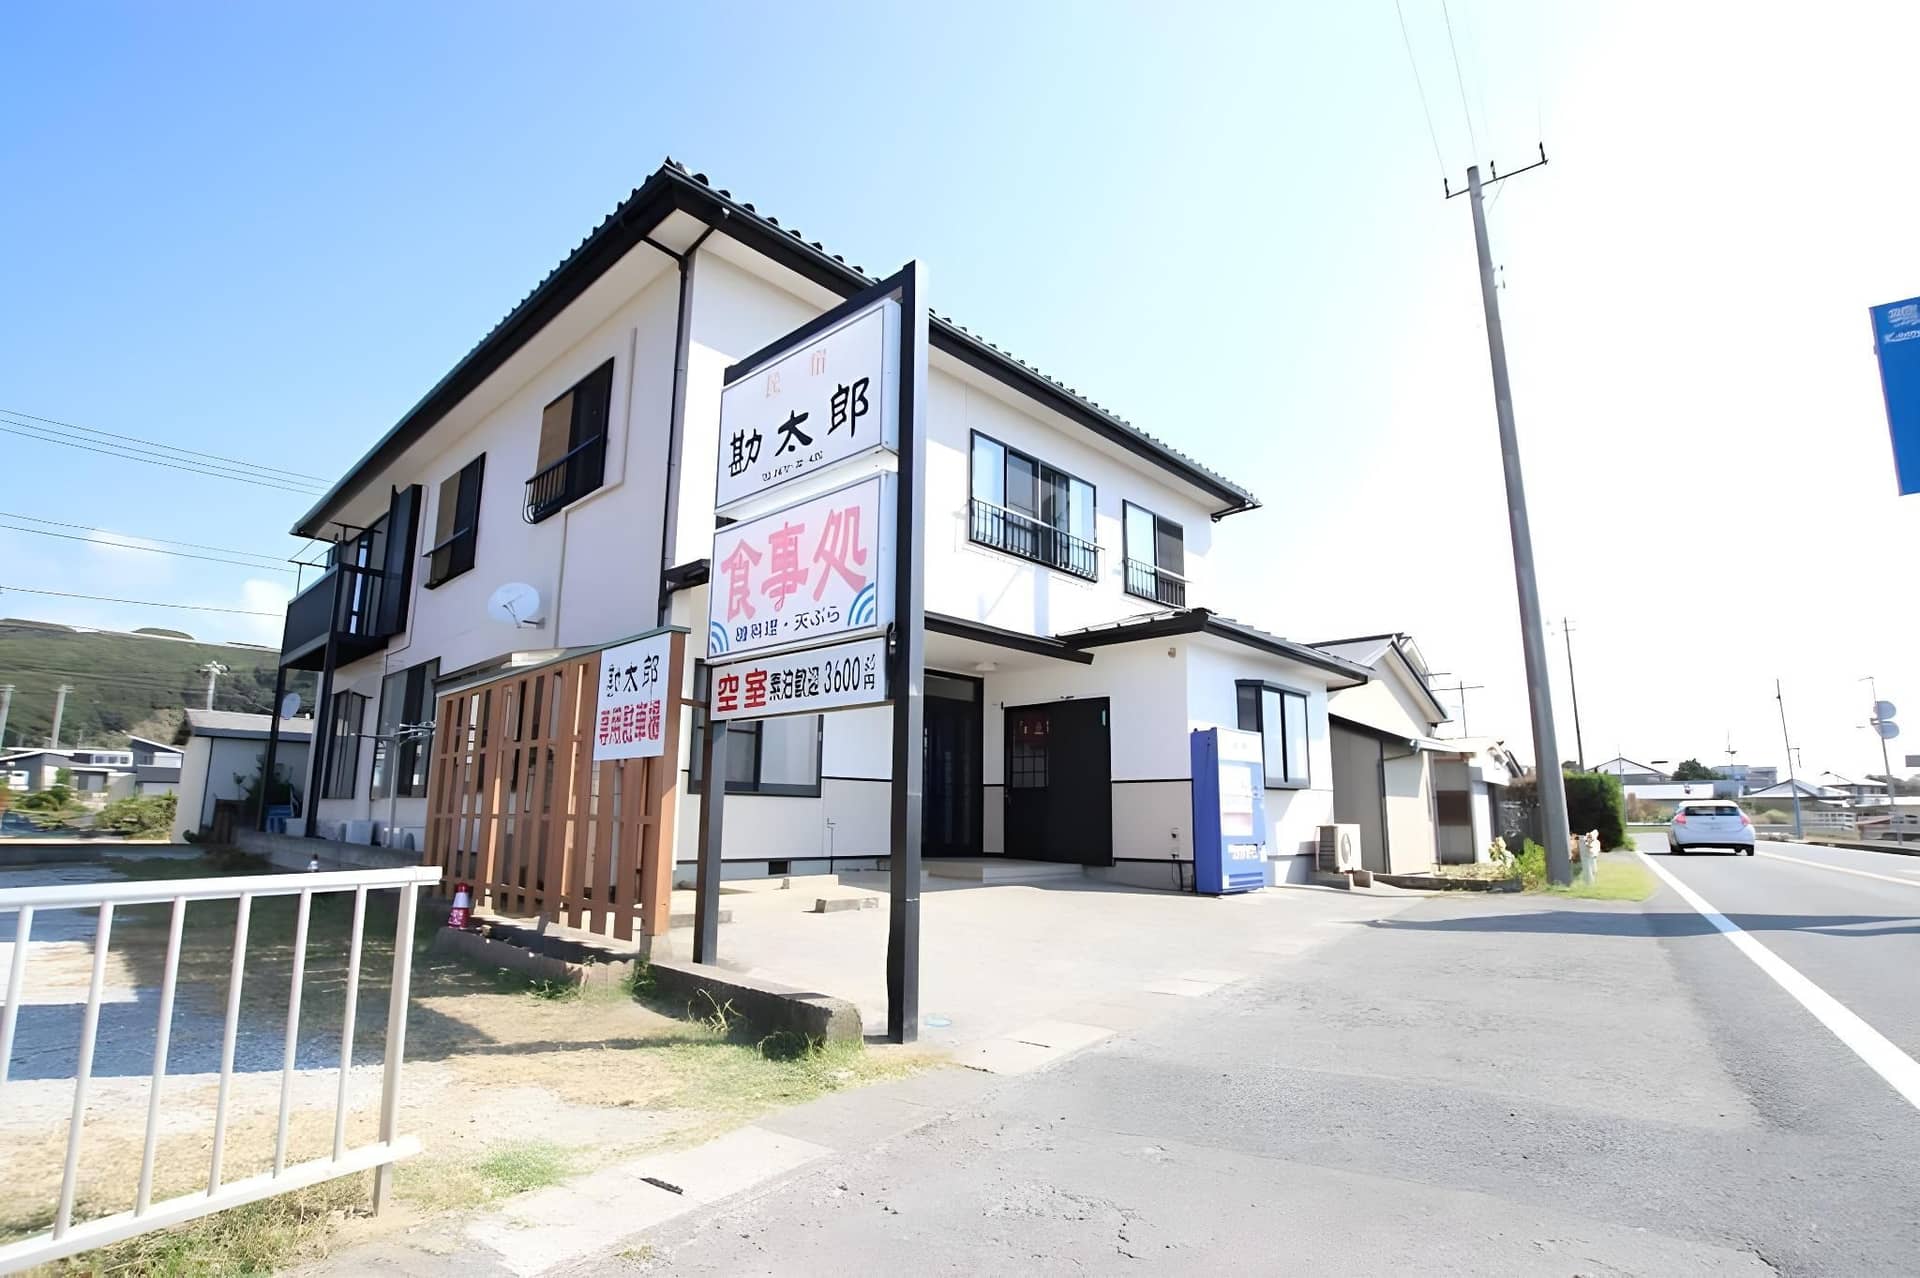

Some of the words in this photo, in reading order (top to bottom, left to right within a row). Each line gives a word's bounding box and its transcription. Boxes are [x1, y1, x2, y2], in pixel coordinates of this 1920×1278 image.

[729, 377, 870, 477] 勘太郎
[721, 505, 868, 623] 食事処
[717, 668, 768, 712] 空室
